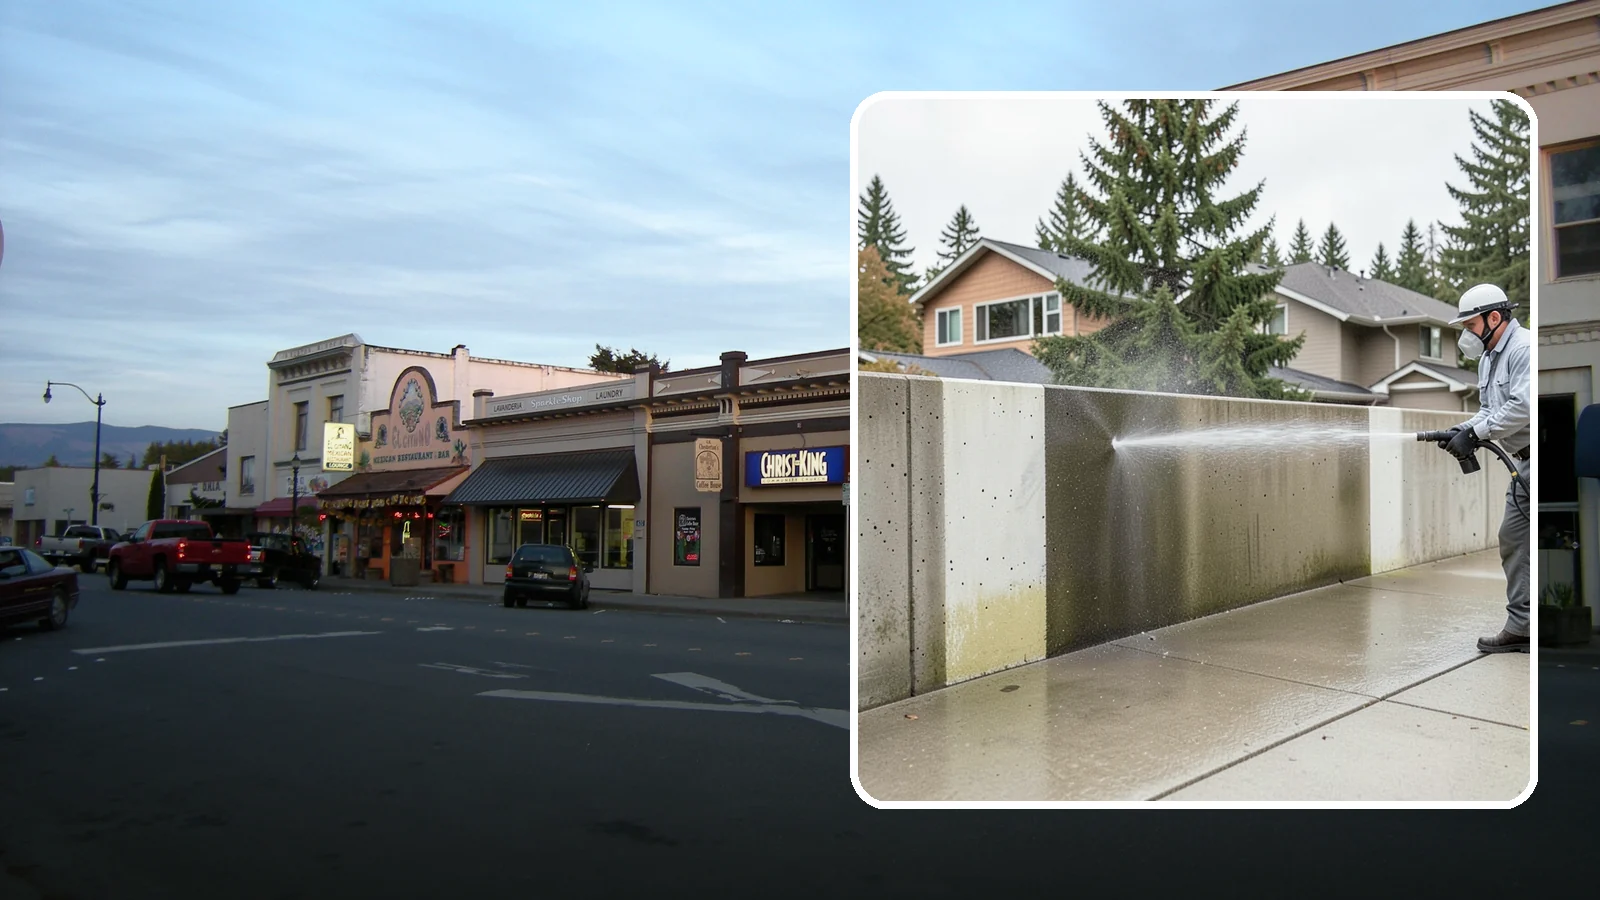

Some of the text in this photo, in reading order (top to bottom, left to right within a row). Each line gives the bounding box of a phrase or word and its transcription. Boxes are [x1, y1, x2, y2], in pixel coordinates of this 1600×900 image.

[562, 394, 582, 404] Shop
[595, 389, 623, 400] LAUNDRY
[493, 402, 522, 412] LAVANDERIA
[397, 451, 433, 462] RESTAURANT
[437, 450, 450, 459] BAR
[761, 450, 827, 478] CHRIST KING
[697, 481, 709, 489] Coffee
